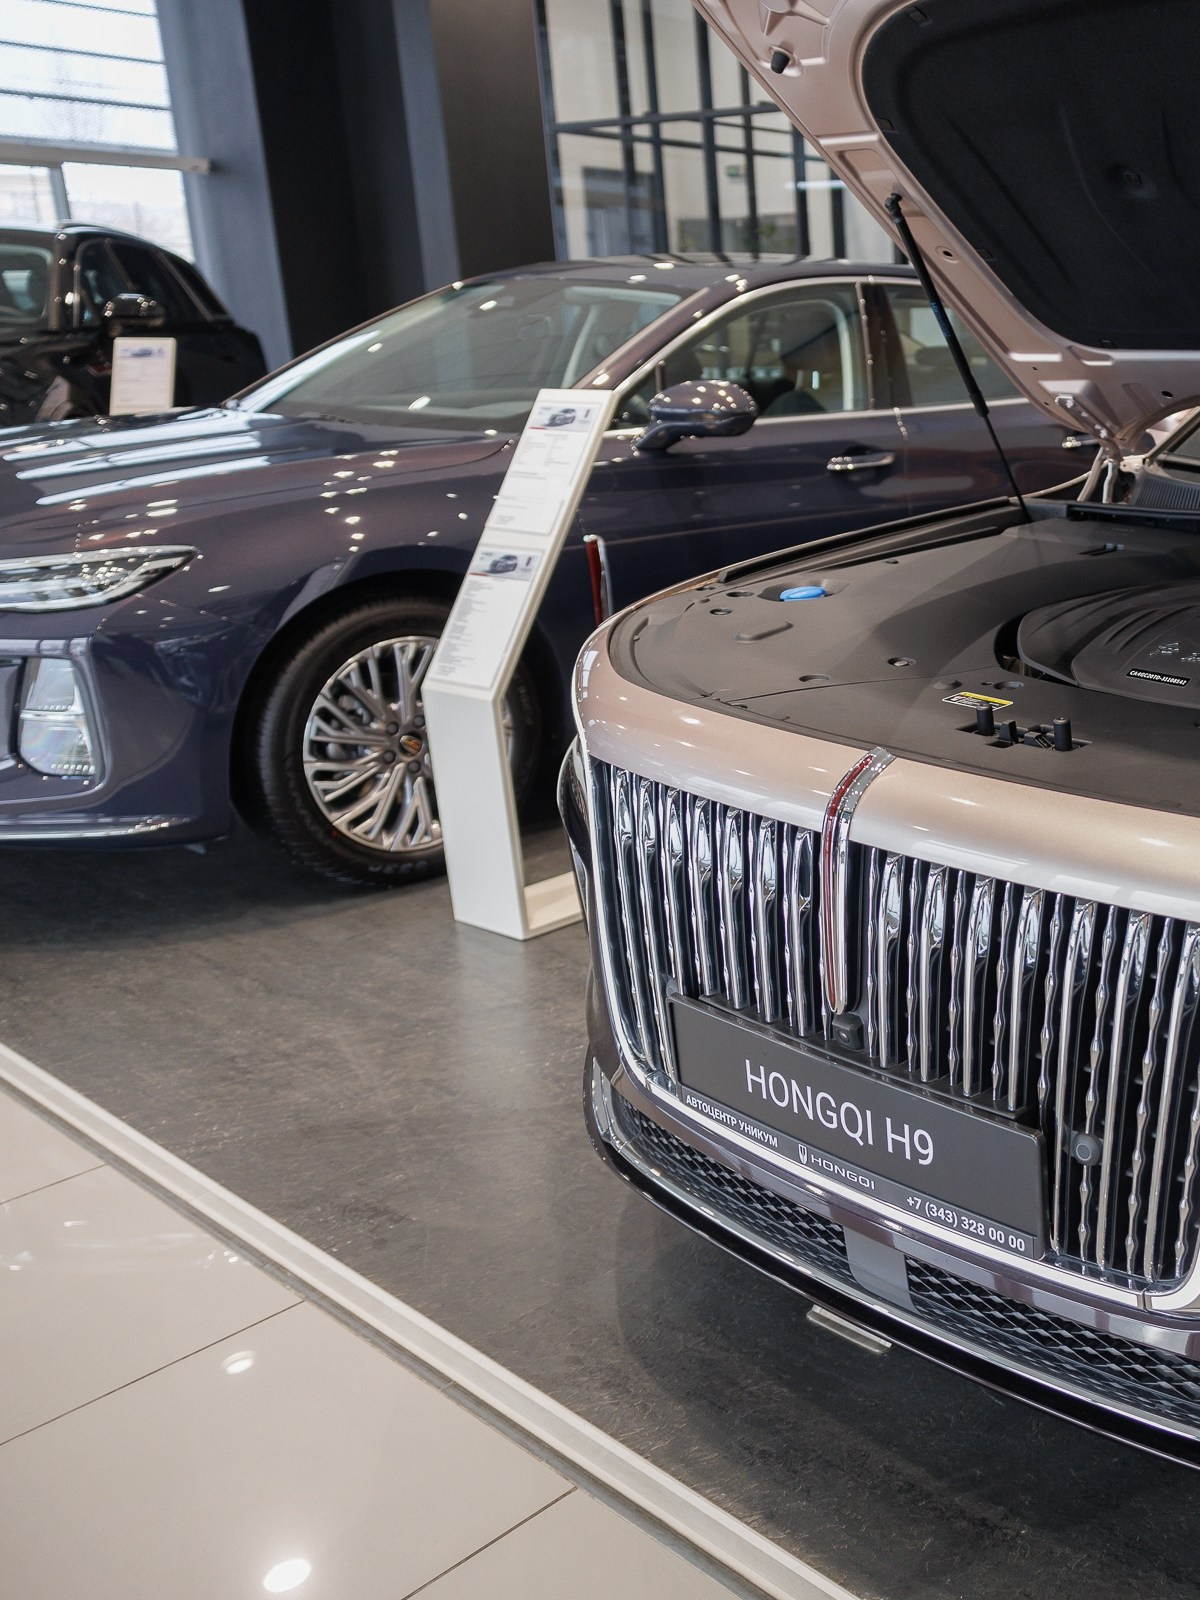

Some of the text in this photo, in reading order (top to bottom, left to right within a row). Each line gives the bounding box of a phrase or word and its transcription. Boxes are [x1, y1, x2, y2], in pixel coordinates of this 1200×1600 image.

[685, 1094, 778, 1147] АВТОЦЕНТР УНИКУМ
[745, 1059, 934, 1166] HONGQI H9
[811, 1154, 875, 1190] HONGQI
[906, 1196, 1025, 1252] +7 (343) 328 00 00
